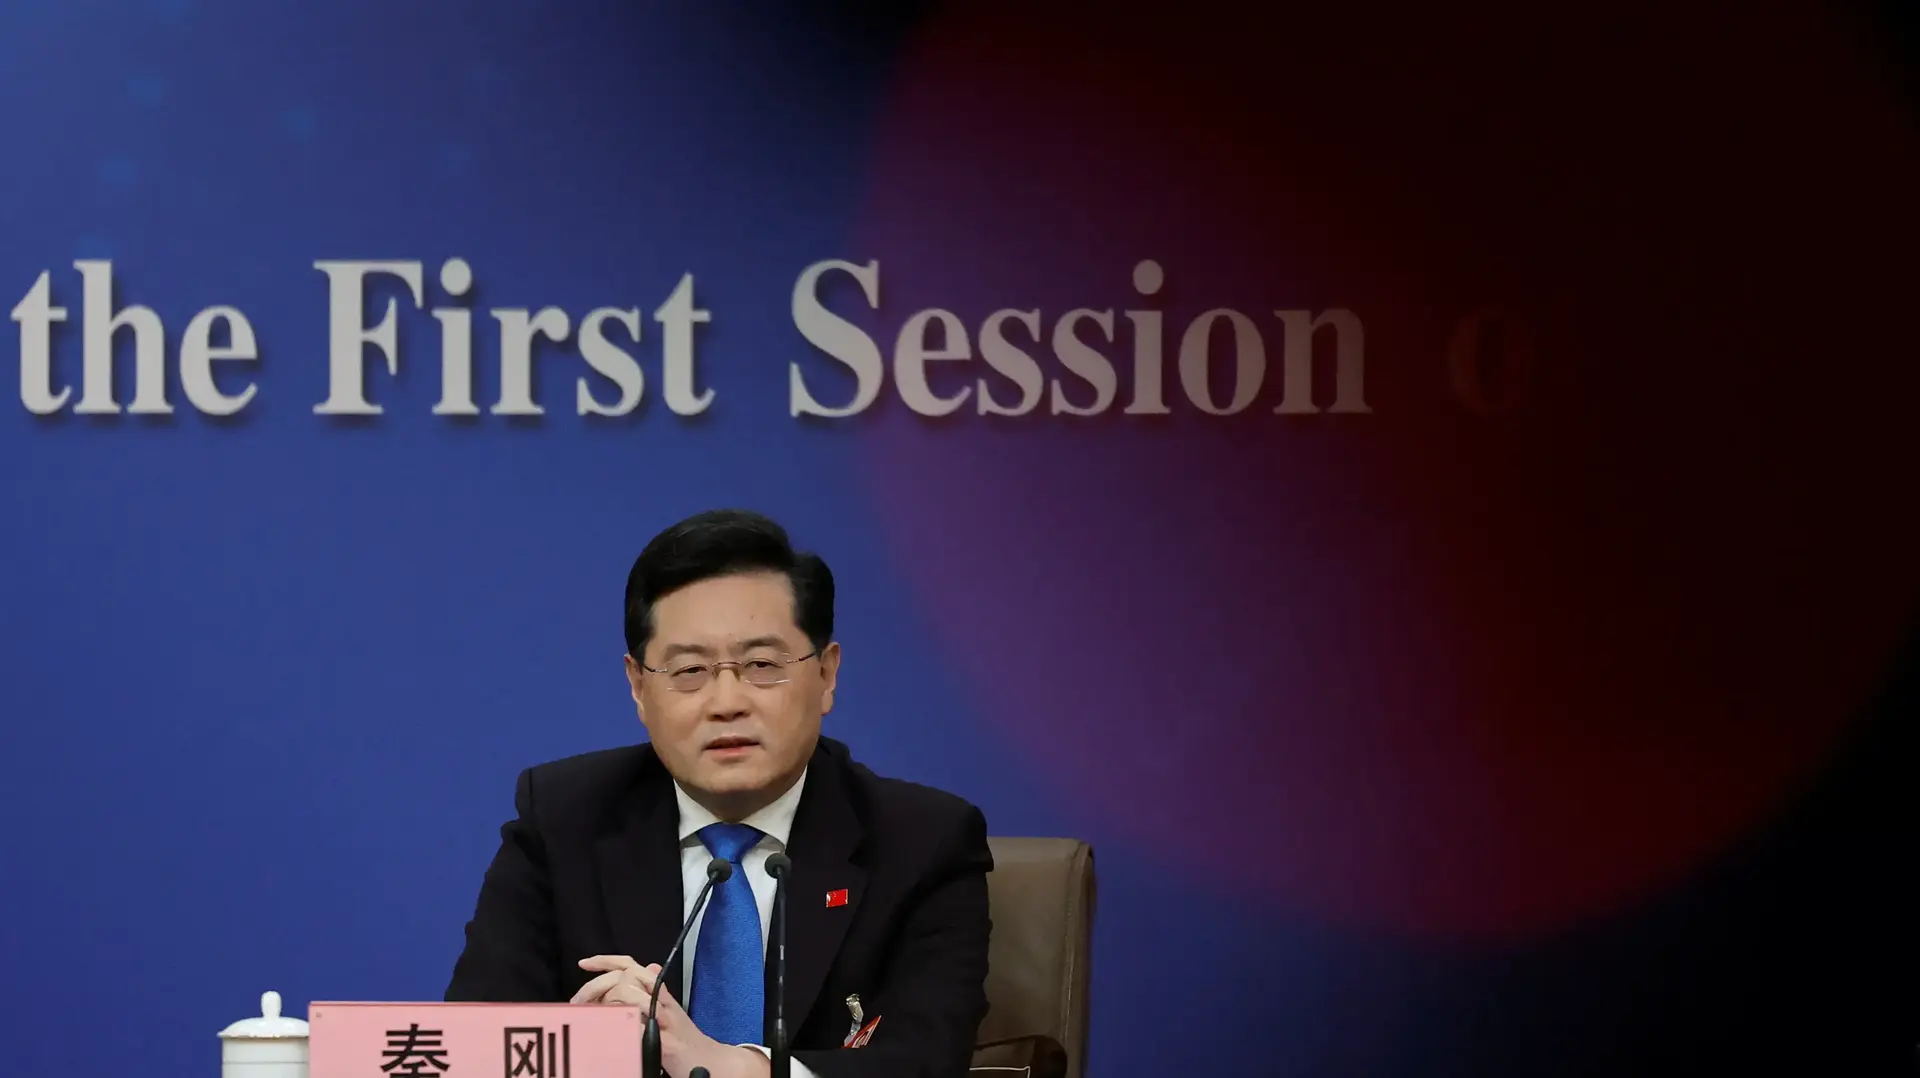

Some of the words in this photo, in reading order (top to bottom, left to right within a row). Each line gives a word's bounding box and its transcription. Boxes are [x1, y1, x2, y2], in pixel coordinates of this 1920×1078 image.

[11, 258, 258, 416] the
[312, 257, 715, 417] First
[789, 259, 1373, 417] Session
